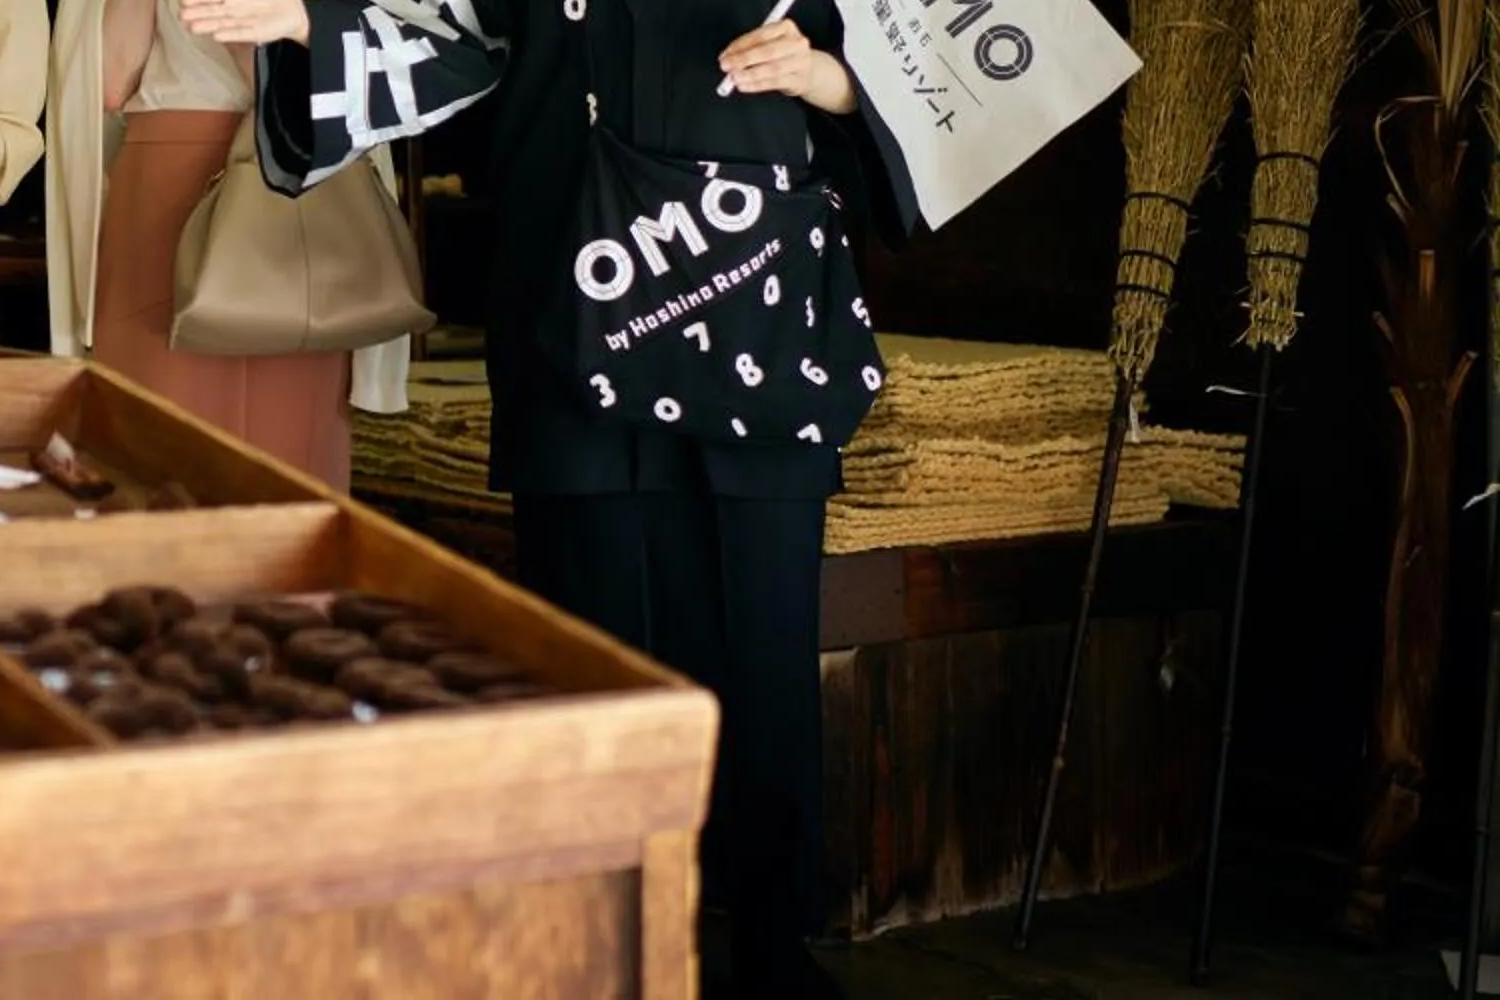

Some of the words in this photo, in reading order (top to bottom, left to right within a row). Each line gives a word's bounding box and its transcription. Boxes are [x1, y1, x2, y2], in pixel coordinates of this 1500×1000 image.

[573, 177, 764, 301] OMO
[604, 329, 631, 351] by
[628, 285, 714, 337] Hoshino
[711, 238, 782, 293] Resorts
[763, 274, 781, 306] 0
[682, 321, 711, 352] 7
[735, 352, 764, 387] 8
[799, 357, 829, 386] 6
[861, 365, 882, 391] 0
[589, 373, 616, 408] 3
[653, 397, 682, 422] 0
